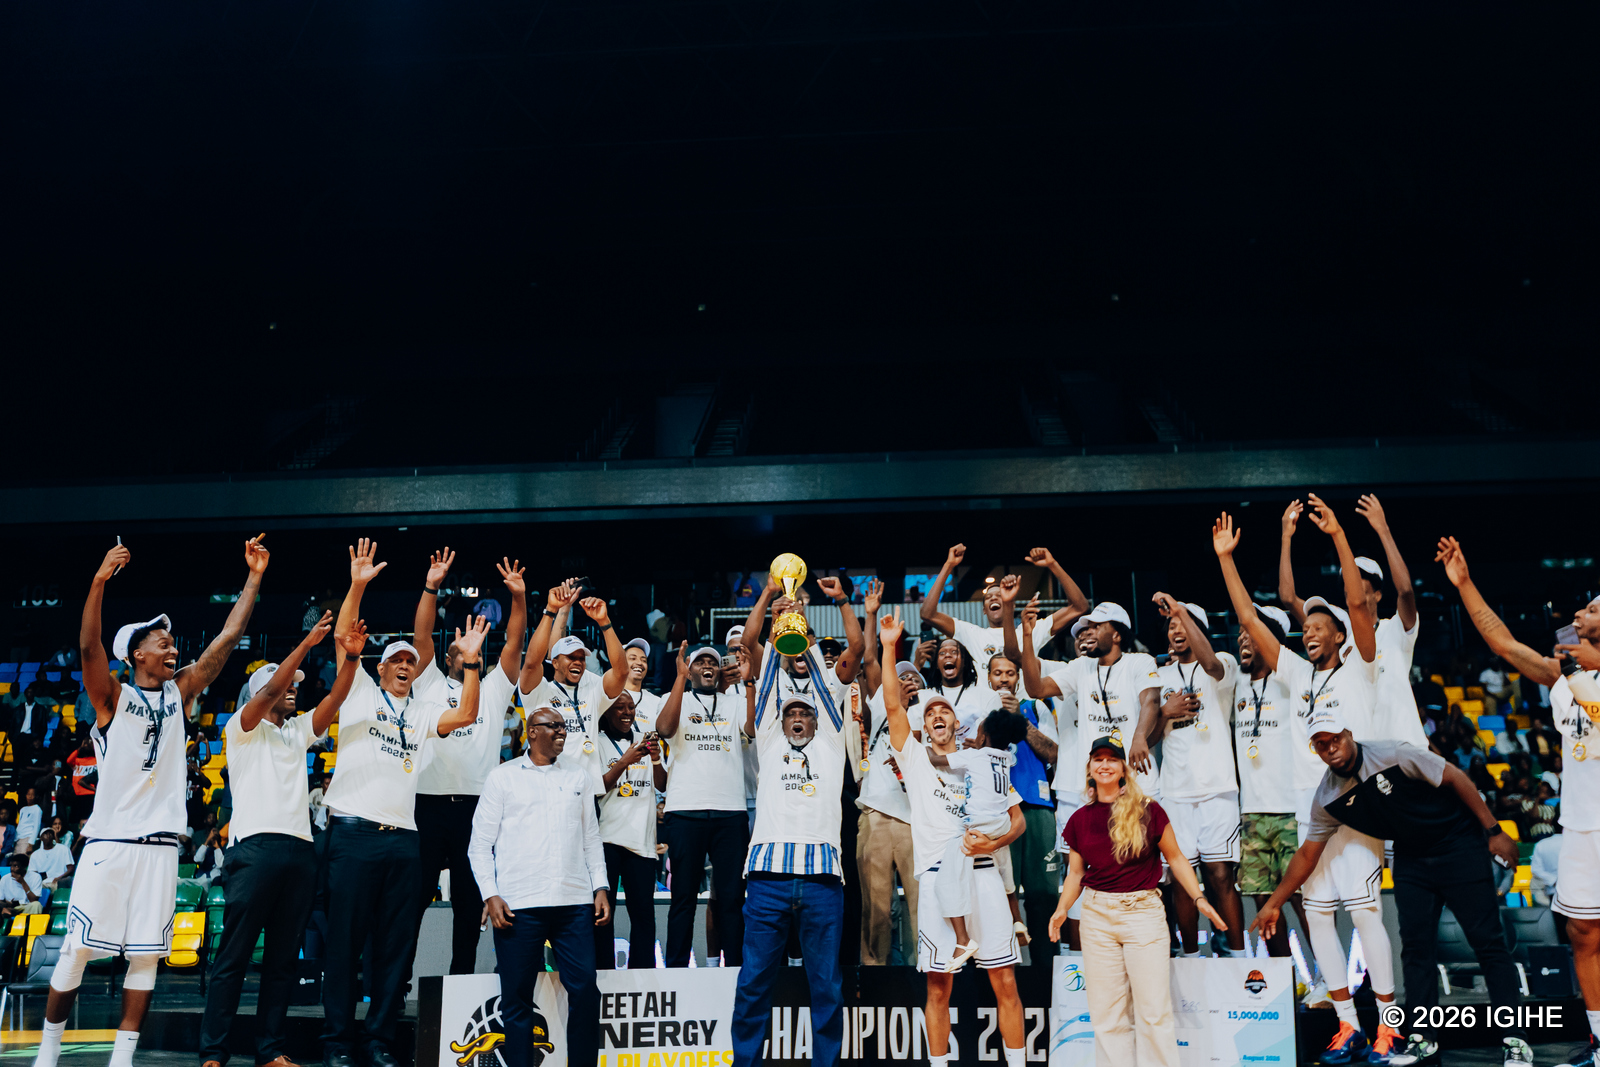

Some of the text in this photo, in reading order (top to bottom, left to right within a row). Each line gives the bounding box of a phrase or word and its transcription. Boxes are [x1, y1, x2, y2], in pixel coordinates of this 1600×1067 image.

[697, 743, 721, 751] 2026
[601, 991, 677, 1019] EETAH
[1227, 1010, 1280, 1022] 15,000,000
[599, 1020, 718, 1050] NERGY
[762, 1006, 1052, 1062] HAPIONS 22
